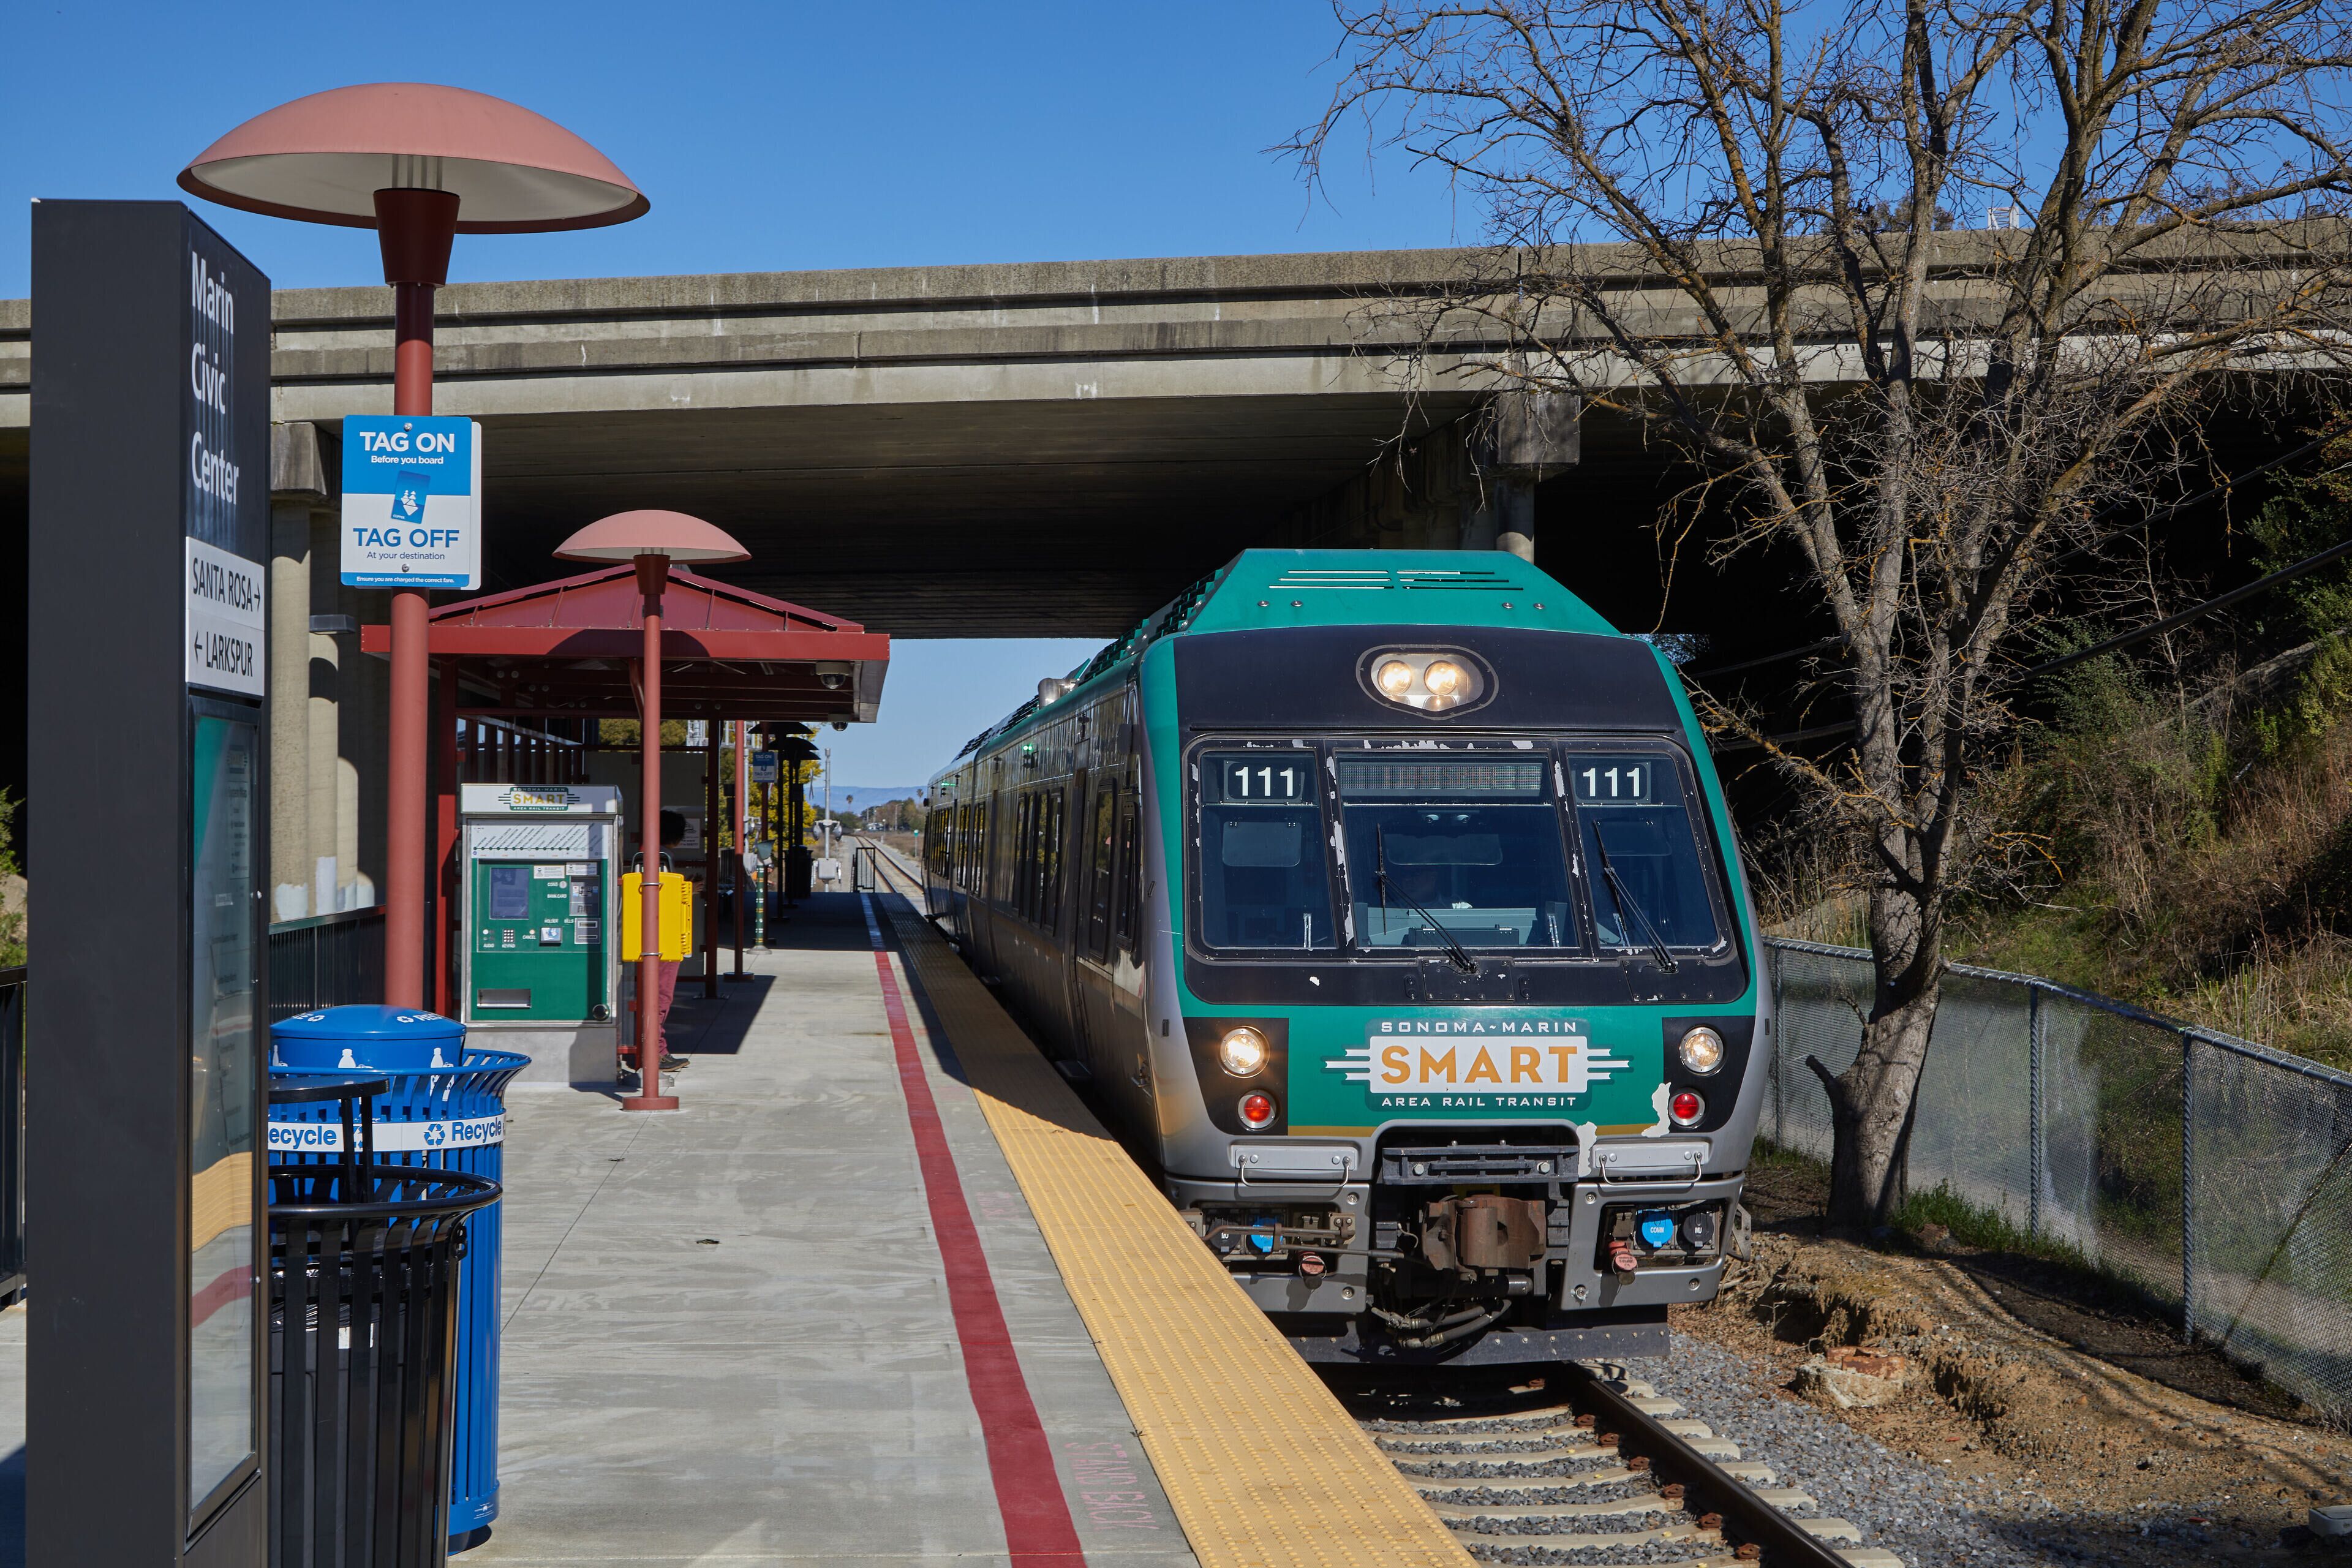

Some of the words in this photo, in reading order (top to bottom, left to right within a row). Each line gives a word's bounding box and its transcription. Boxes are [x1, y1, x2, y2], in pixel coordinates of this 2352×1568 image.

[192, 251, 234, 334] Marin
[192, 342, 226, 415] Civic
[360, 432, 409, 452] TAG
[416, 432, 455, 453] ON
[192, 431, 239, 505] Center
[418, 456, 443, 464] board
[353, 528, 401, 547] TAG
[409, 529, 460, 548] OFF
[399, 551, 445, 560] destination
[194, 557, 225, 603] SANTA
[228, 570, 253, 612] ROSA
[206, 631, 253, 677] LARKSPUR
[1235, 766, 1294, 797] 111
[1583, 767, 1640, 797] 111
[513, 794, 565, 804] SMART
[1381, 1044, 1578, 1084] SMART
[1381, 1096, 1431, 1107] AREA
[1442, 1096, 1486, 1107] RAIL
[1496, 1096, 1577, 1107] TRANSIT
[268, 1125, 337, 1150] ecycle
[451, 1117, 502, 1144] Recycle
